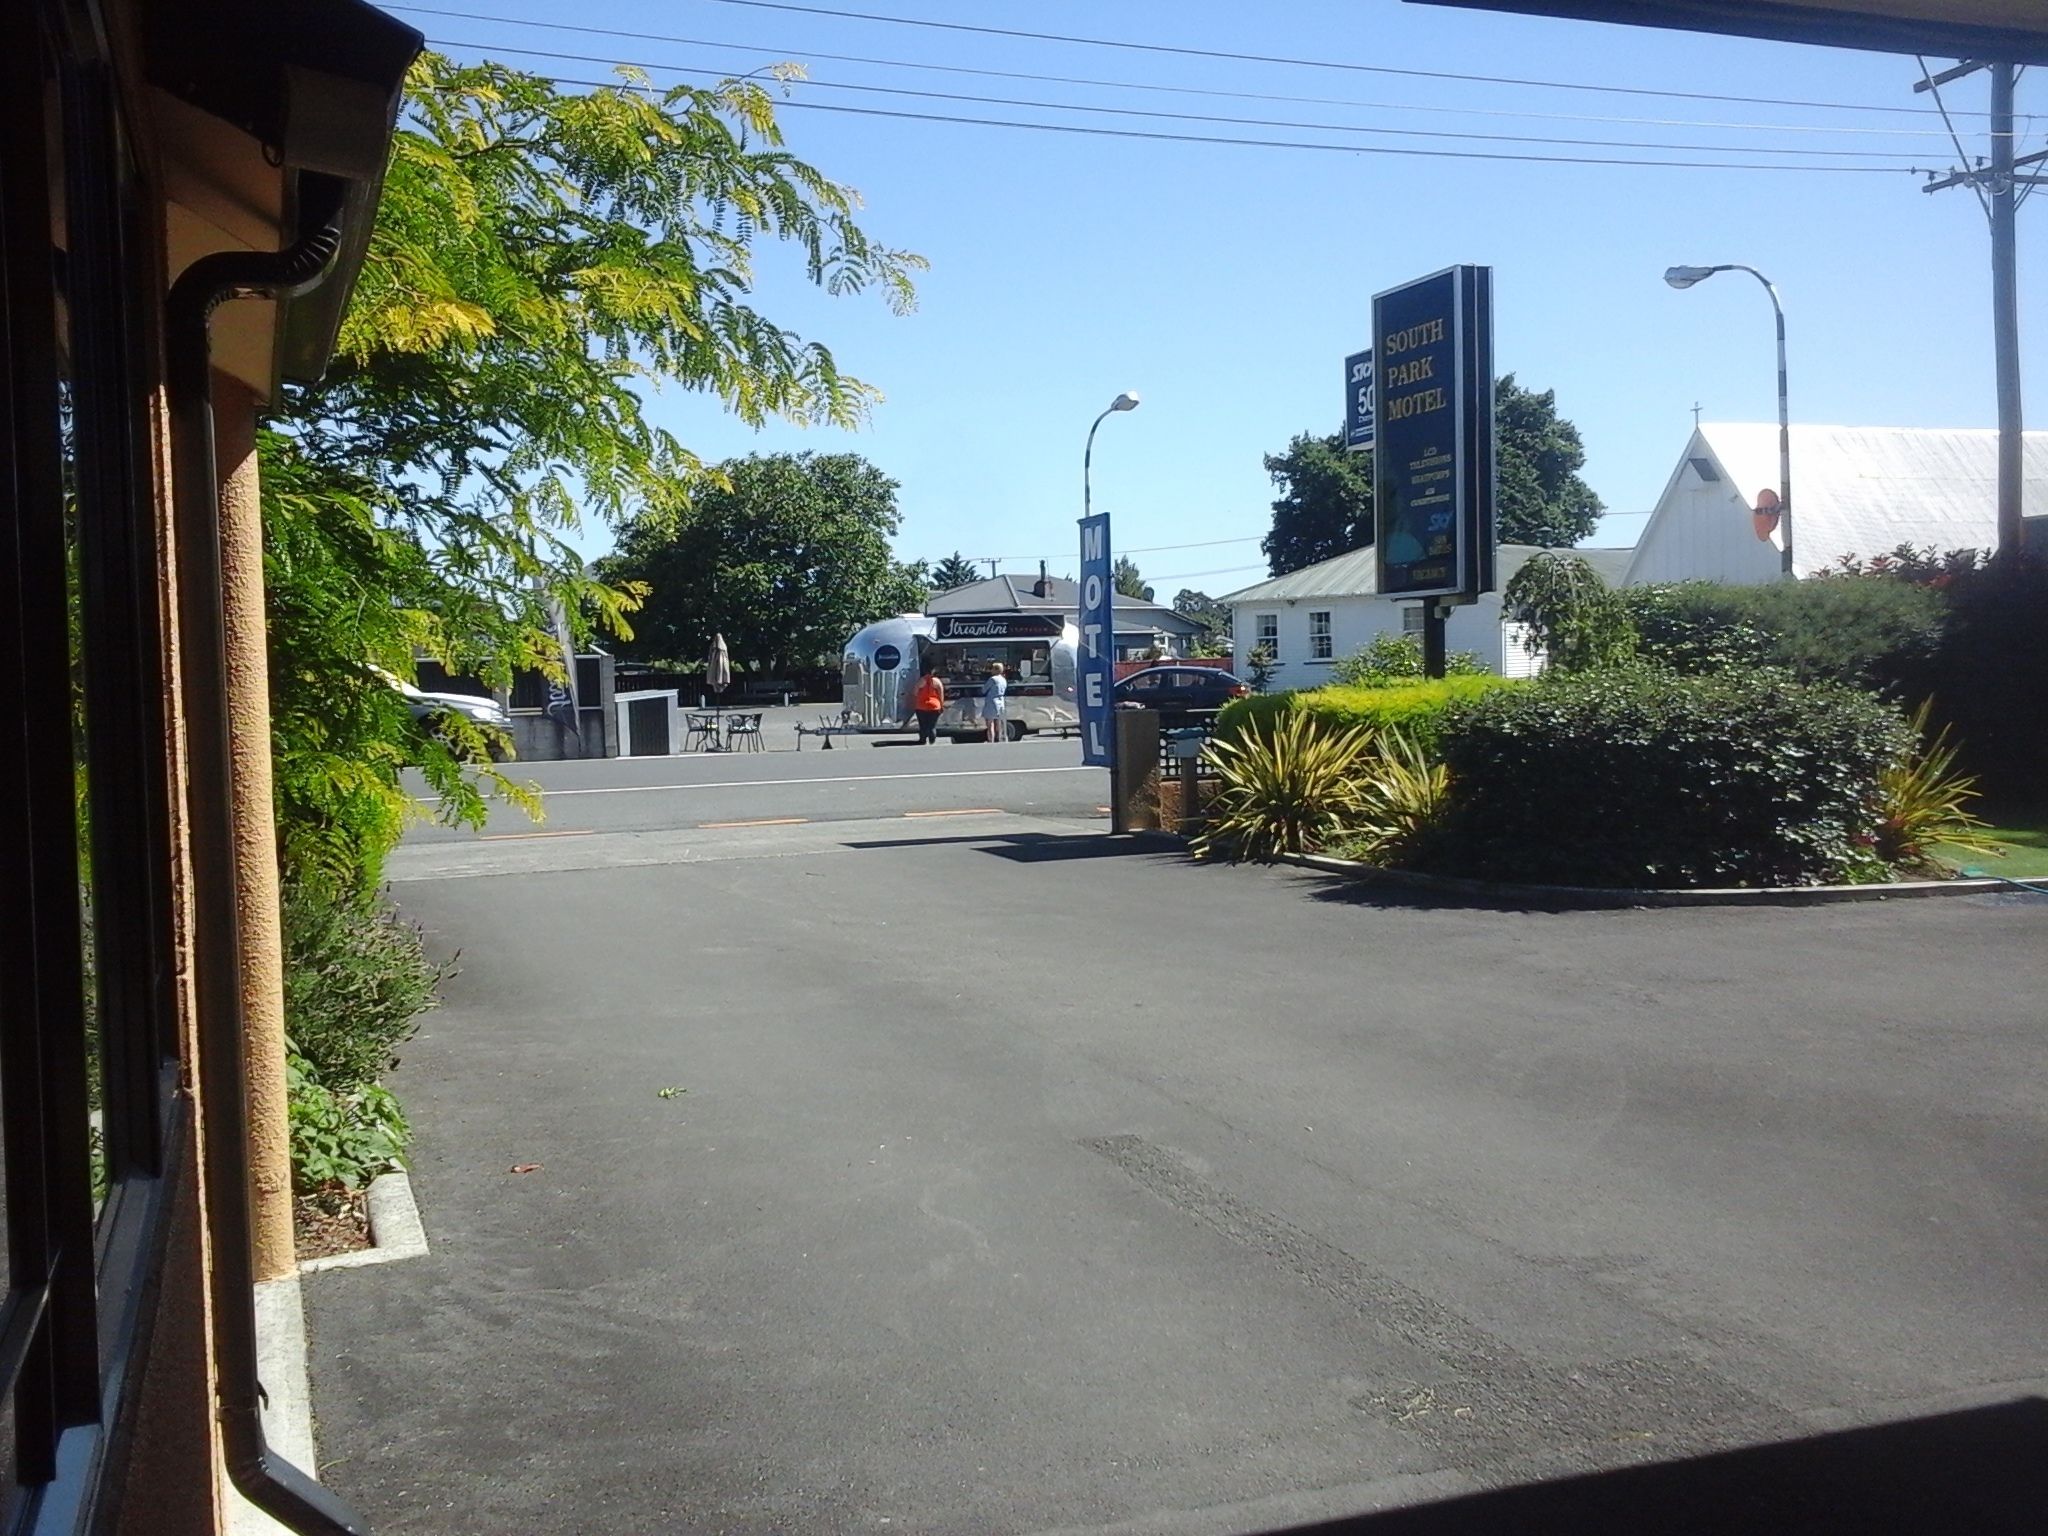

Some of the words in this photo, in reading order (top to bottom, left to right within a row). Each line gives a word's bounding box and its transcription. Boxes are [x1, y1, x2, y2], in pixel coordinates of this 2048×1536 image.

[1386, 318, 1443, 356] SOUTH
[1388, 356, 1433, 388] PARK
[1388, 387, 1446, 421] MOTEL
[1084, 524, 1105, 756] MOTEL
